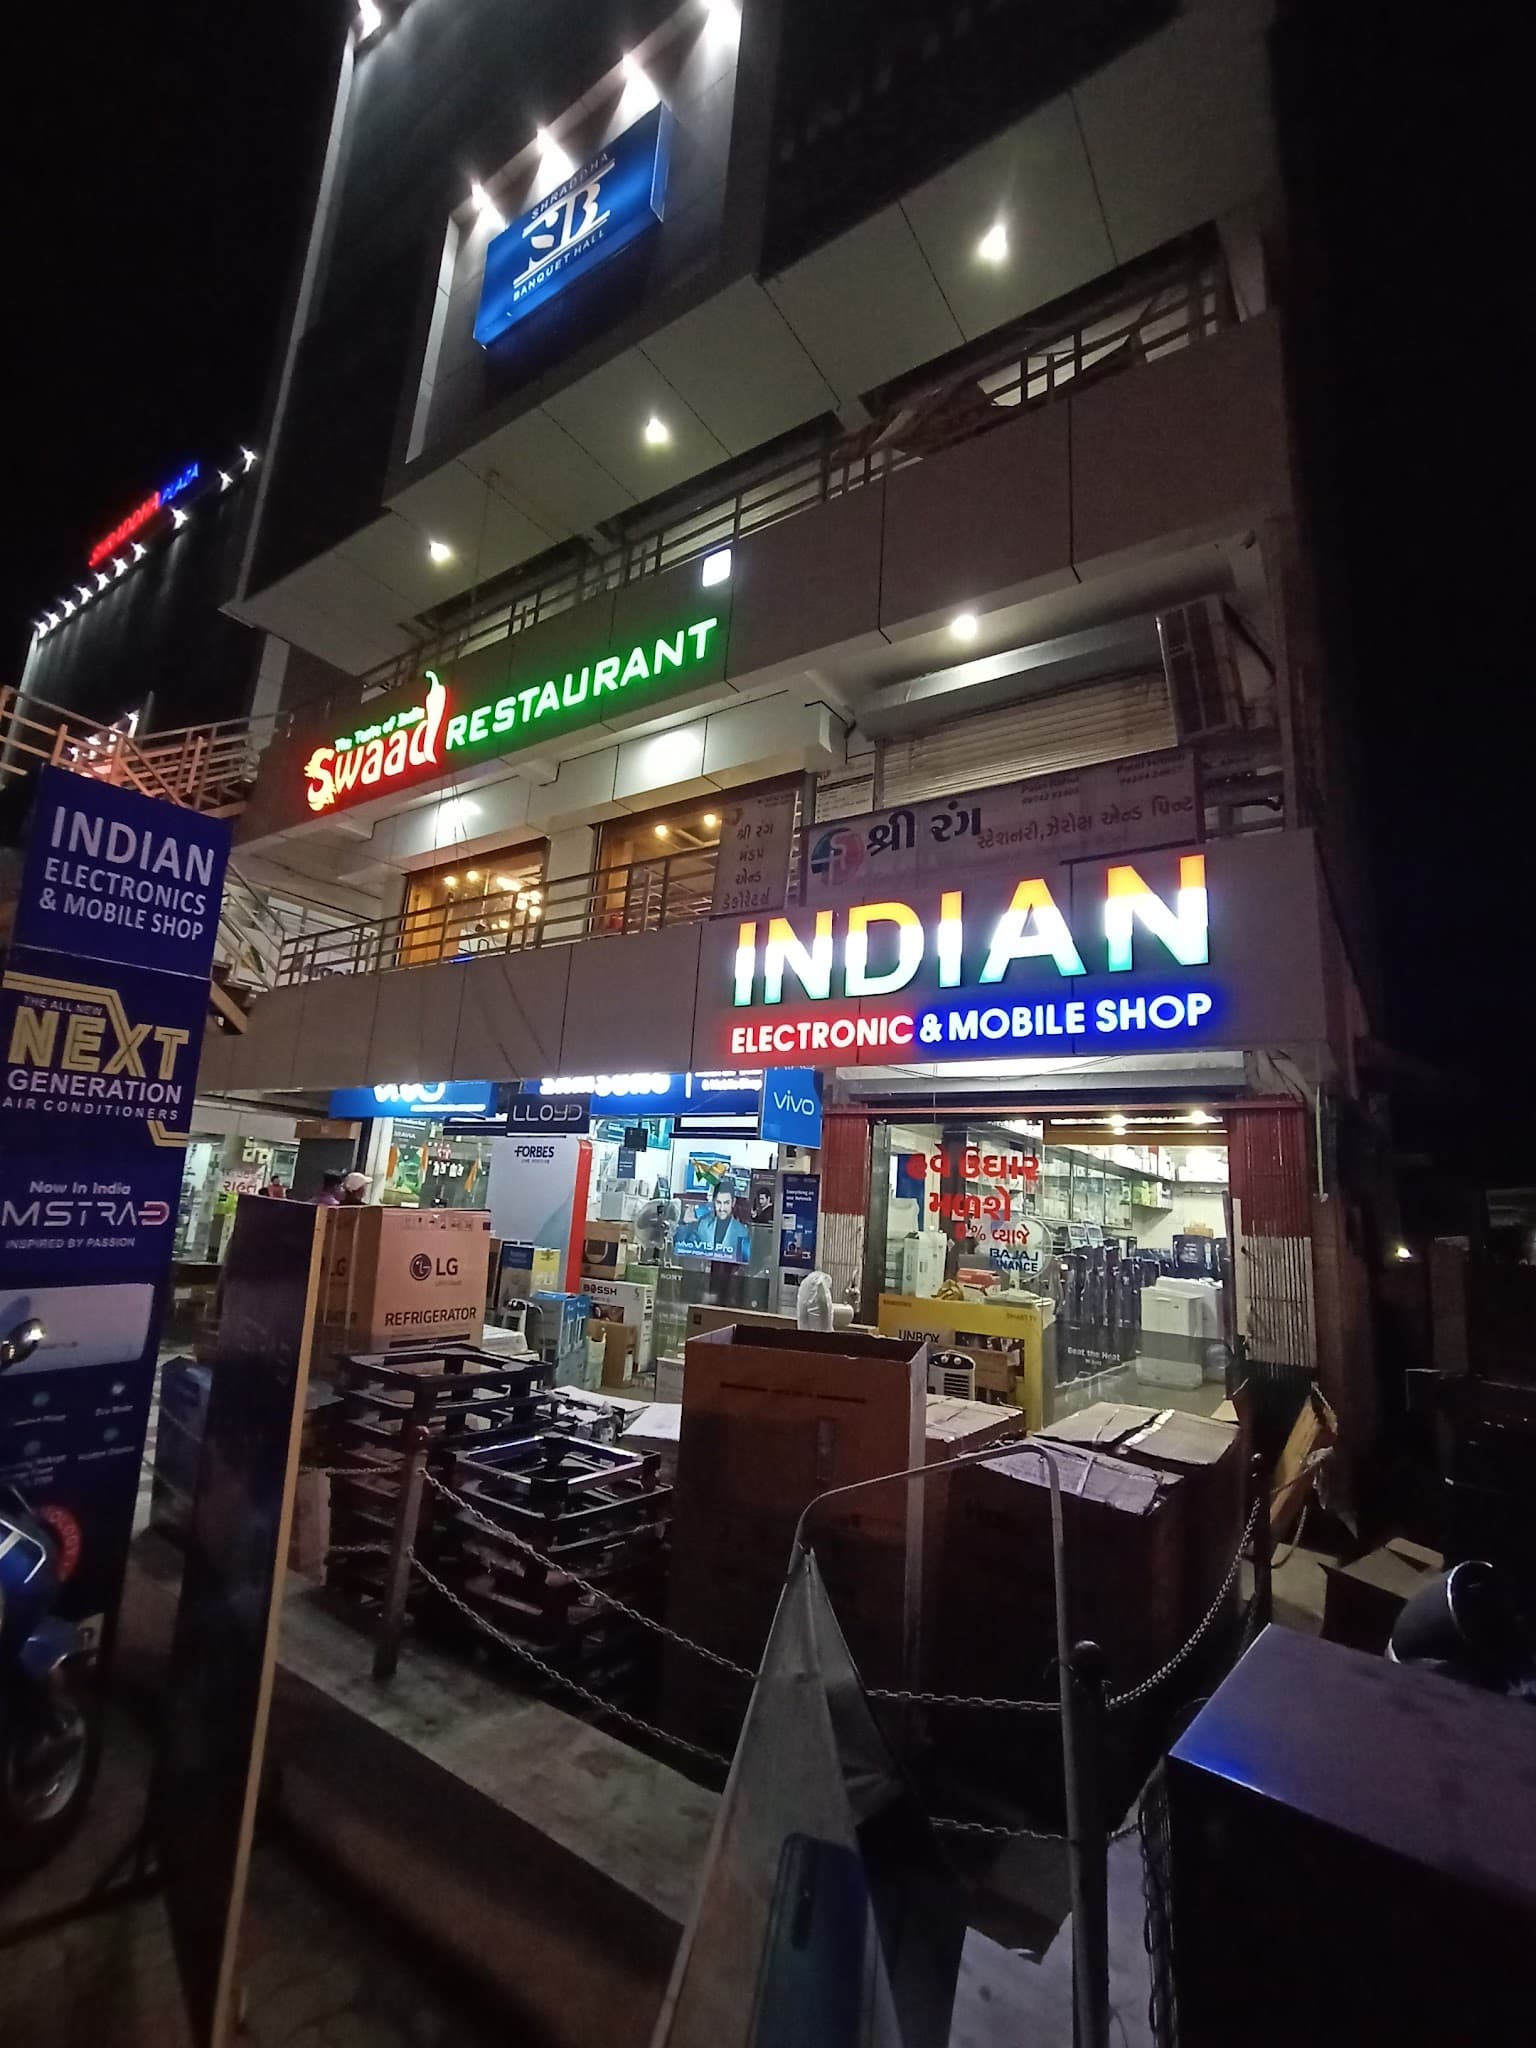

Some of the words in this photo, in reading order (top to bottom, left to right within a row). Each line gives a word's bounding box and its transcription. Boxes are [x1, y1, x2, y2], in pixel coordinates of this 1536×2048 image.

[513, 253, 571, 302] BANQUET
[574, 229, 604, 256] HALL
[303, 670, 448, 812] Swaad
[445, 617, 718, 751] RESTAURANT
[867, 810, 915, 857] શ્રી
[931, 801, 981, 842] રંગ
[51, 806, 214, 886] INDIAN
[44, 857, 206, 915] ELECTRONICS
[39, 888, 56, 911] &
[63, 893, 147, 930] MOBILE
[151, 913, 204, 941] SHOP
[734, 855, 1211, 1007] INDIAN
[50, 1000, 72, 1013] ALL
[731, 1015, 914, 1055] ELECTRONIC
[919, 1013, 943, 1045] &
[949, 1001, 1086, 1042] MOBILE
[1096, 993, 1213, 1033] SHOP
[8, 1005, 190, 1080] NEXT
[7, 1069, 182, 1104] GENERATION
[2, 1095, 36, 1110] AIR
[43, 1099, 178, 1121] CONDITIONERS
[512, 1104, 583, 1122] LLOYD
[773, 1089, 815, 1116] vivo
[514, 1145, 555, 1158] FORBES
[29, 1181, 67, 1194] Now
[72, 1182, 88, 1194] In
[93, 1182, 131, 1195] India
[5, 1239, 64, 1249] INSPIRED
[67, 1238, 83, 1249] BY
[86, 1237, 136, 1249] PASSION
[990, 1247, 1039, 1262] BAJAJ
[436, 1257, 459, 1276] LG
[661, 1273, 683, 1282] SONY
[384, 1307, 477, 1327] REFRIGERATOR
[898, 1329, 941, 1345] UNBOX
[1087, 1349, 1100, 1359] the
[1102, 1351, 1121, 1362] Heat
